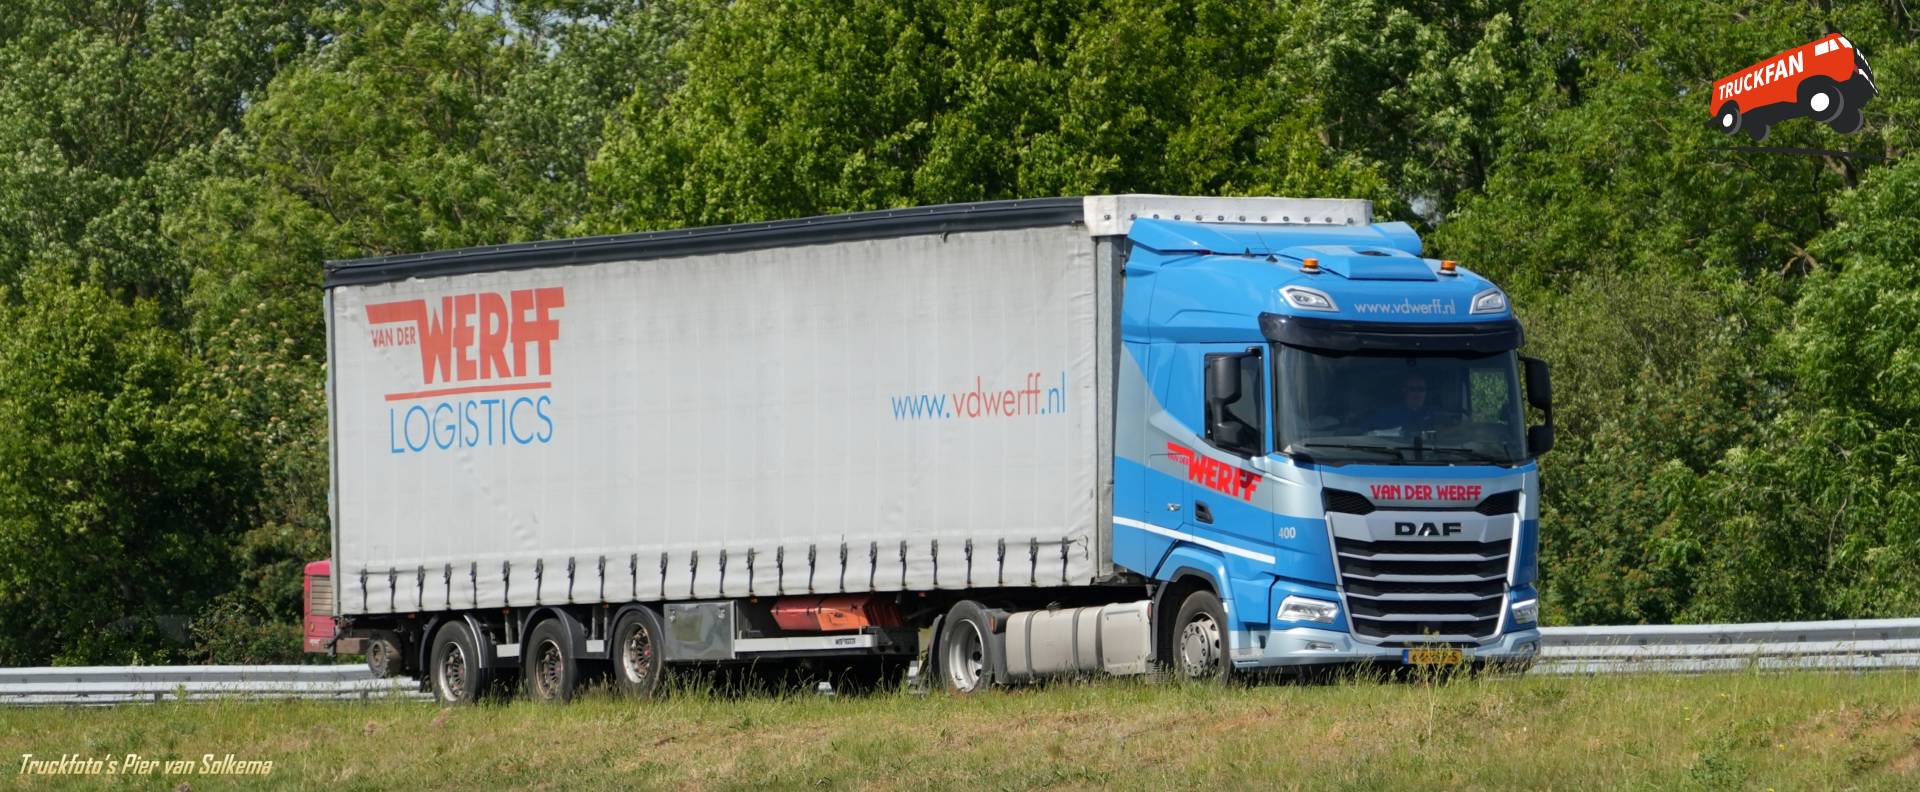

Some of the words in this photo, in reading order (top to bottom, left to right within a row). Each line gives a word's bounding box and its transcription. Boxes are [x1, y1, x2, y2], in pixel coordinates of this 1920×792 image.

[1354, 297, 1455, 315] www.vdwerff.nl
[371, 329, 394, 348] VAN
[397, 326, 416, 345] DER
[417, 286, 565, 385] WERFF
[891, 371, 1066, 420] www.vdwerff.nl
[390, 395, 553, 454] LOGISTICS
[1188, 450, 1262, 502] WERFF
[1370, 485, 1402, 500] VAN
[1405, 485, 1432, 500] DER
[1437, 485, 1482, 501] WERFF
[1278, 527, 1297, 539] 400
[1394, 522, 1462, 536] DAF
